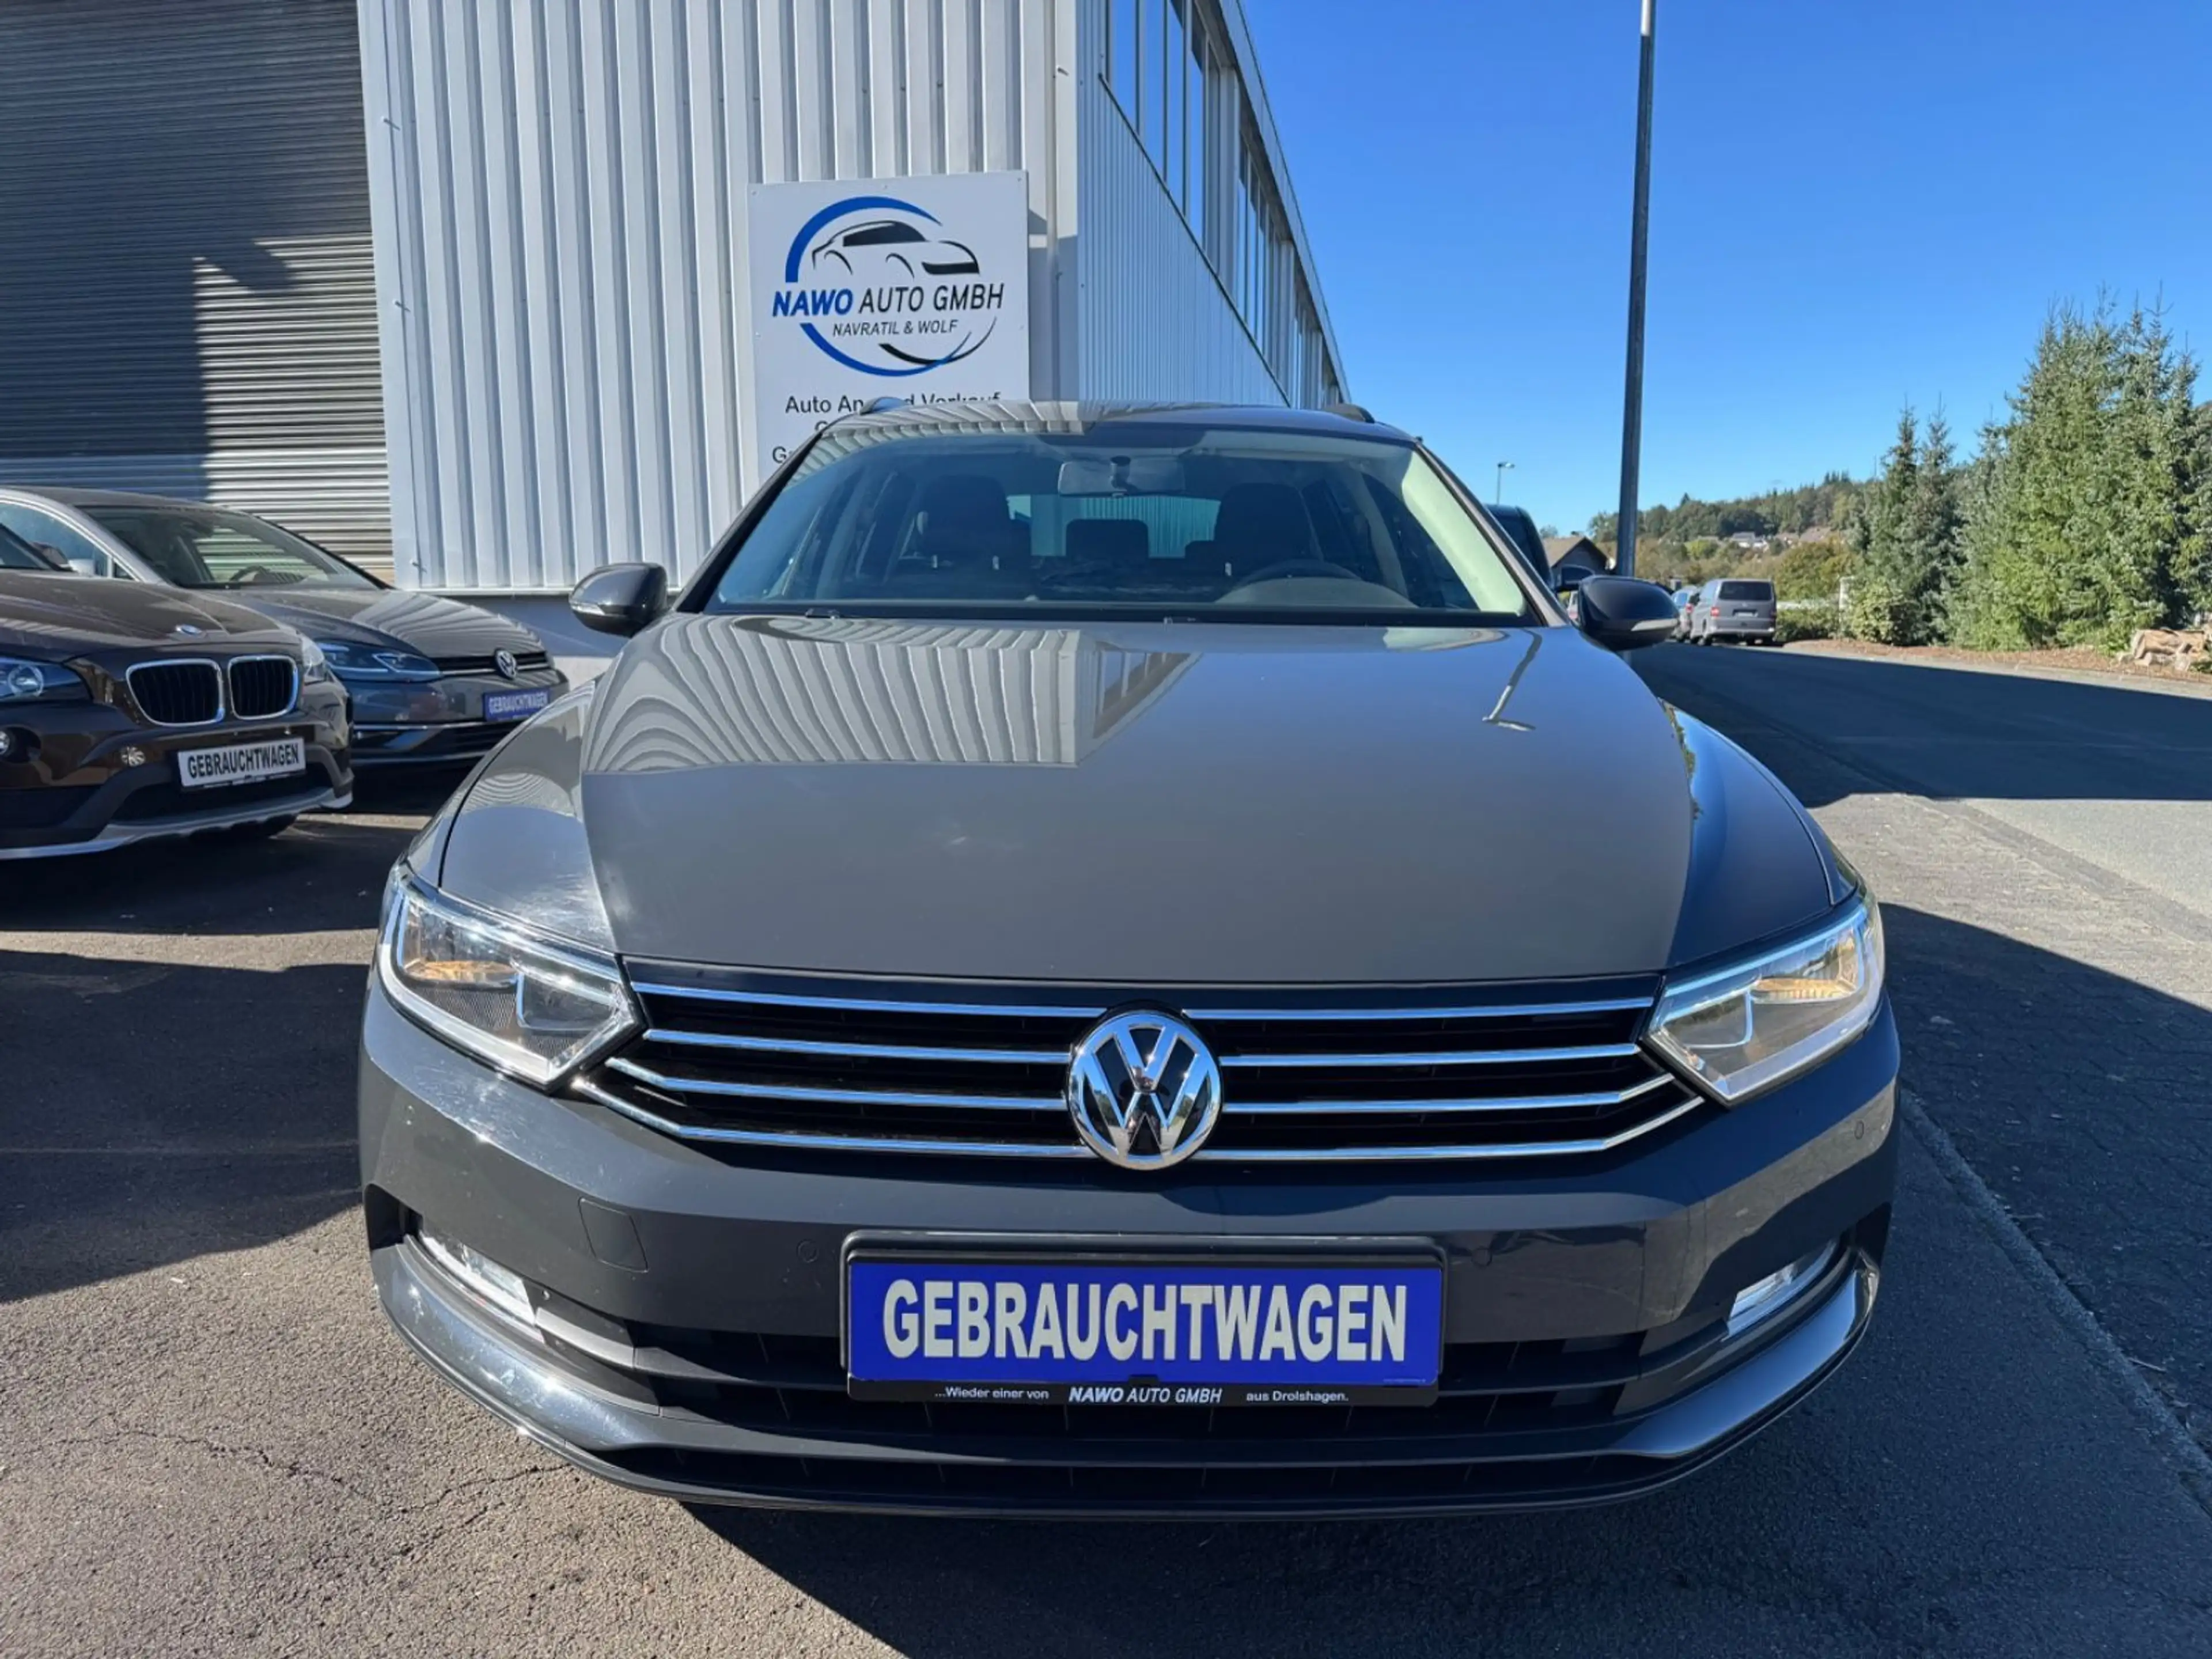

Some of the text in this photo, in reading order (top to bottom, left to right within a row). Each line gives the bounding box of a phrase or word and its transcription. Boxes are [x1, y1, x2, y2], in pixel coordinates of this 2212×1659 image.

[772, 283, 1005, 317] NAWO AUTO GMBH
[832, 319, 959, 337] NAVRATIL & WOLF
[785, 395, 832, 413] Auto
[188, 743, 300, 779] GEBRAUCHTWAGEN
[882, 1278, 1408, 1362] GEBRAUCHTWAGEN
[992, 1388, 1023, 1399] einer
[1027, 1391, 1049, 1400] von
[1069, 1387, 1123, 1403] NAWO
[1126, 1387, 1171, 1403] AUTO
[1175, 1388, 1223, 1404] GMBH
[1246, 1391, 1269, 1402] aus
[1272, 1390, 1349, 1404] Drolshagen.
